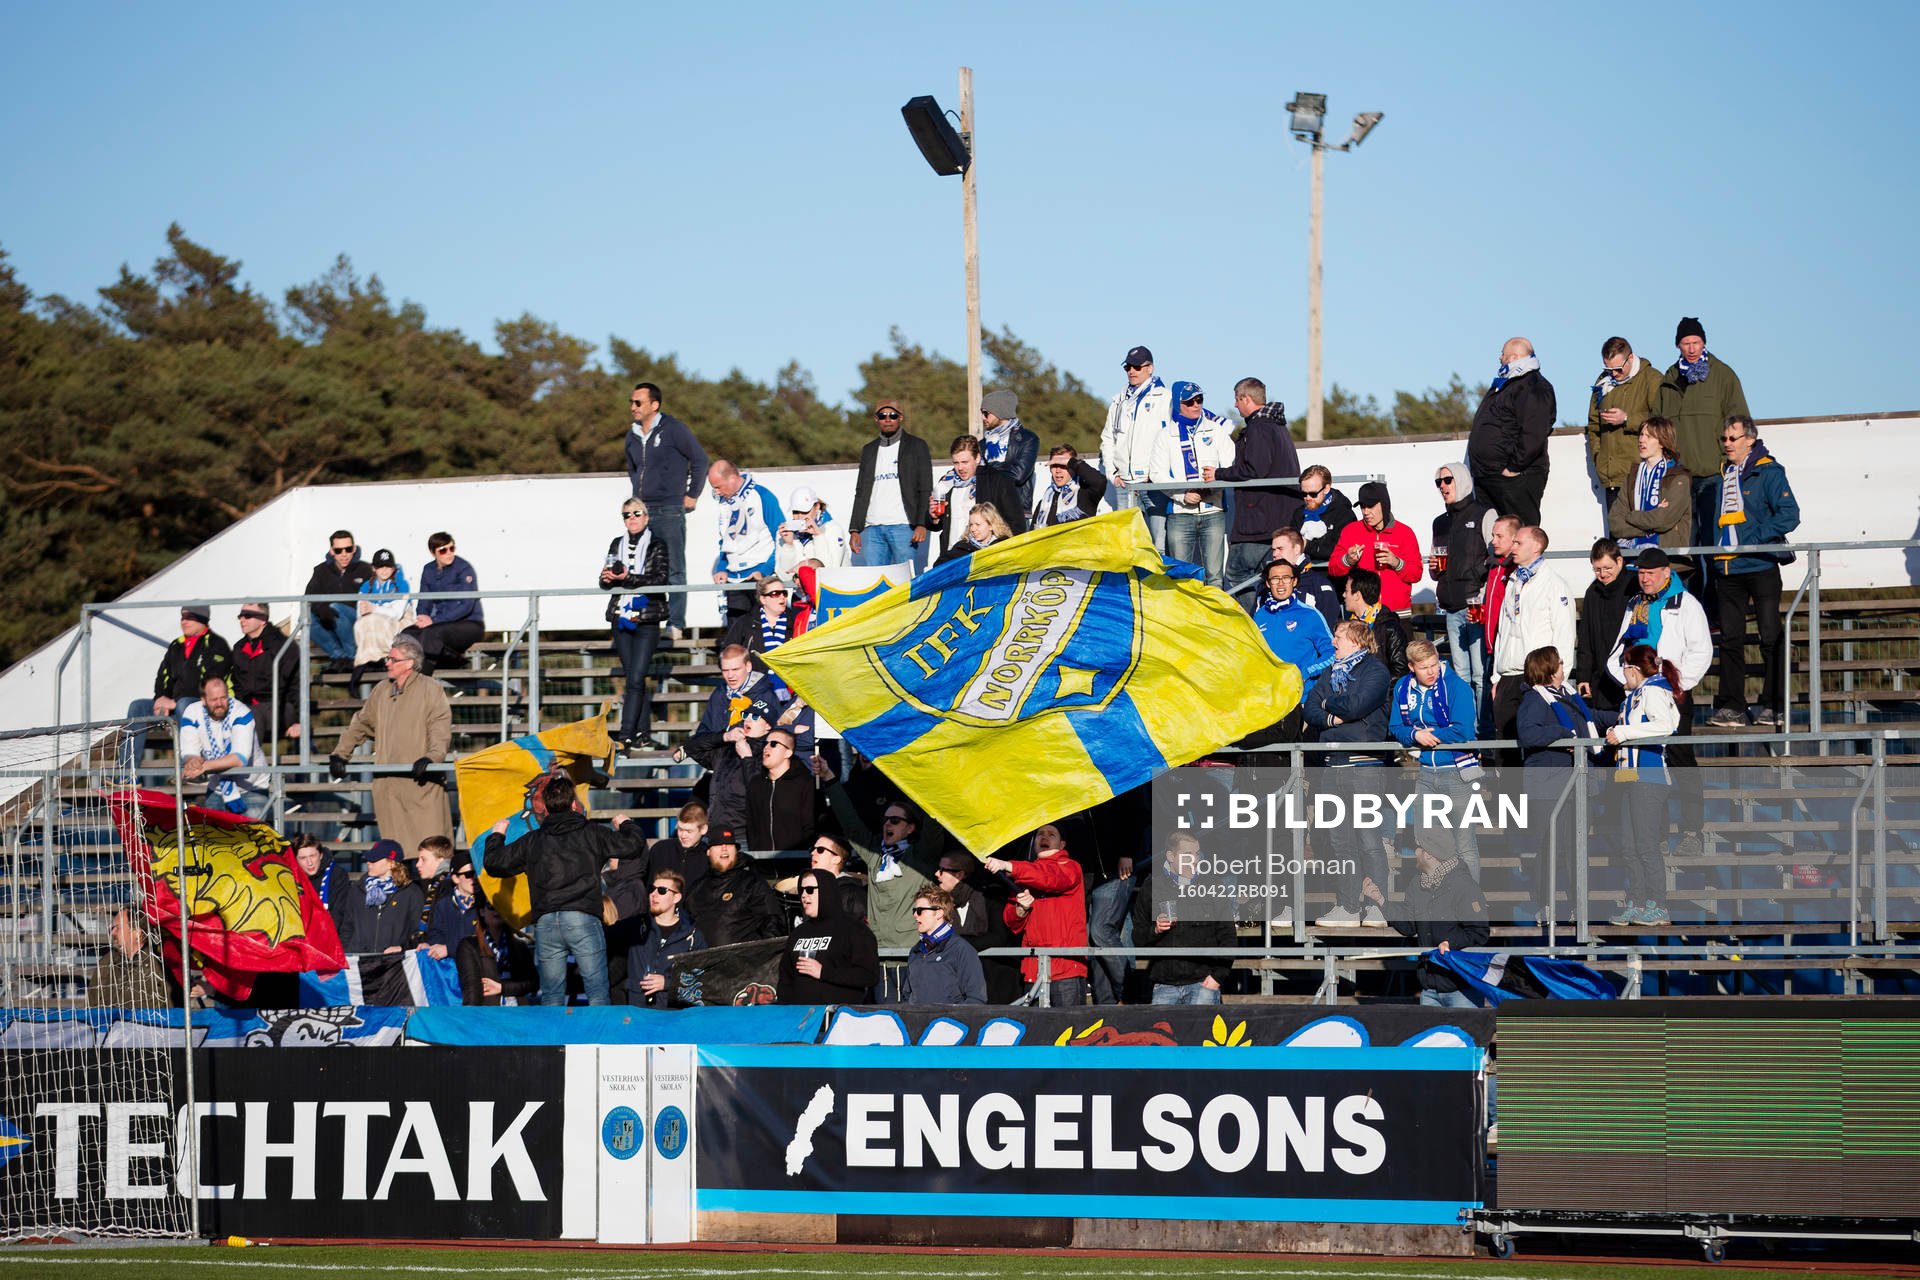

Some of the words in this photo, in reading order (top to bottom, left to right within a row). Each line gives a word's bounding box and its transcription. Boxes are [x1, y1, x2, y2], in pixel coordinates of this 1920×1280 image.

[902, 586, 996, 681] IFK
[978, 570, 1076, 711] NORRKÖP
[602, 1074, 645, 1083] VESTERHAVS
[608, 1083, 636, 1092] SKOLAN
[660, 1082, 682, 1091] SKOLAN
[36, 1101, 548, 1201] TECHTAK
[846, 1092, 1386, 1174] ENGELSONS
